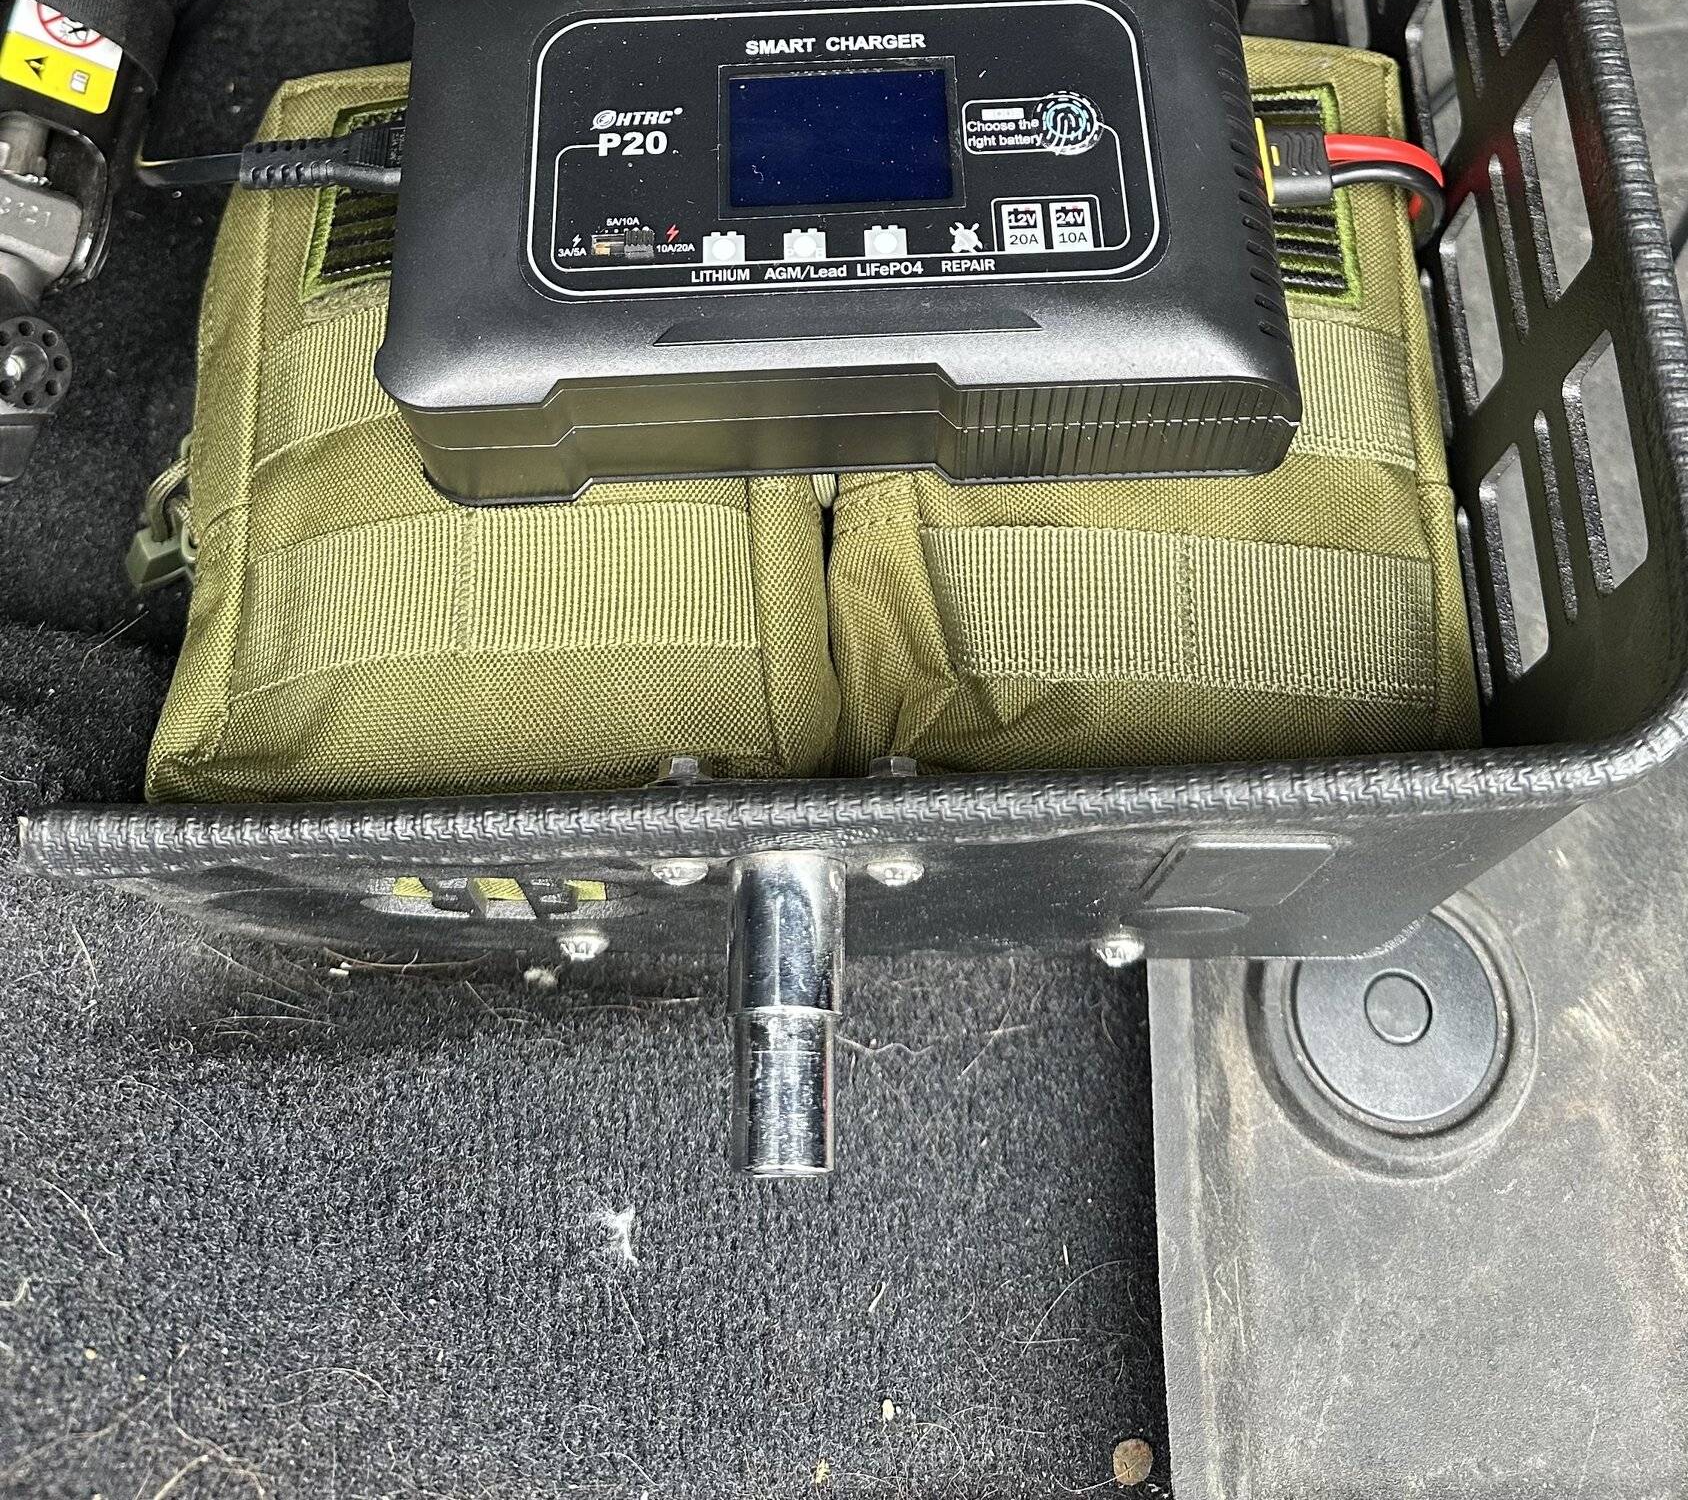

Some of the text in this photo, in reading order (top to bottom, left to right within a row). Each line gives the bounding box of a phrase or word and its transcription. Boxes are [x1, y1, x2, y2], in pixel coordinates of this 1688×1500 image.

[746, 34, 926, 55] SMART CHARGER
[615, 110, 674, 126] HTRC
[967, 118, 1039, 133] Choose the
[598, 131, 667, 156] P20
[968, 133, 1043, 149] right battery
[1008, 211, 1084, 226] 12V 24V
[1009, 231, 1088, 246] 20A 10A
[557, 247, 587, 258] 3A/5A
[656, 243, 696, 254] 10A/20A
[691, 268, 750, 283] LITHIUM
[764, 264, 847, 281] AGM/Lead
[941, 258, 996, 273] REPAIR
